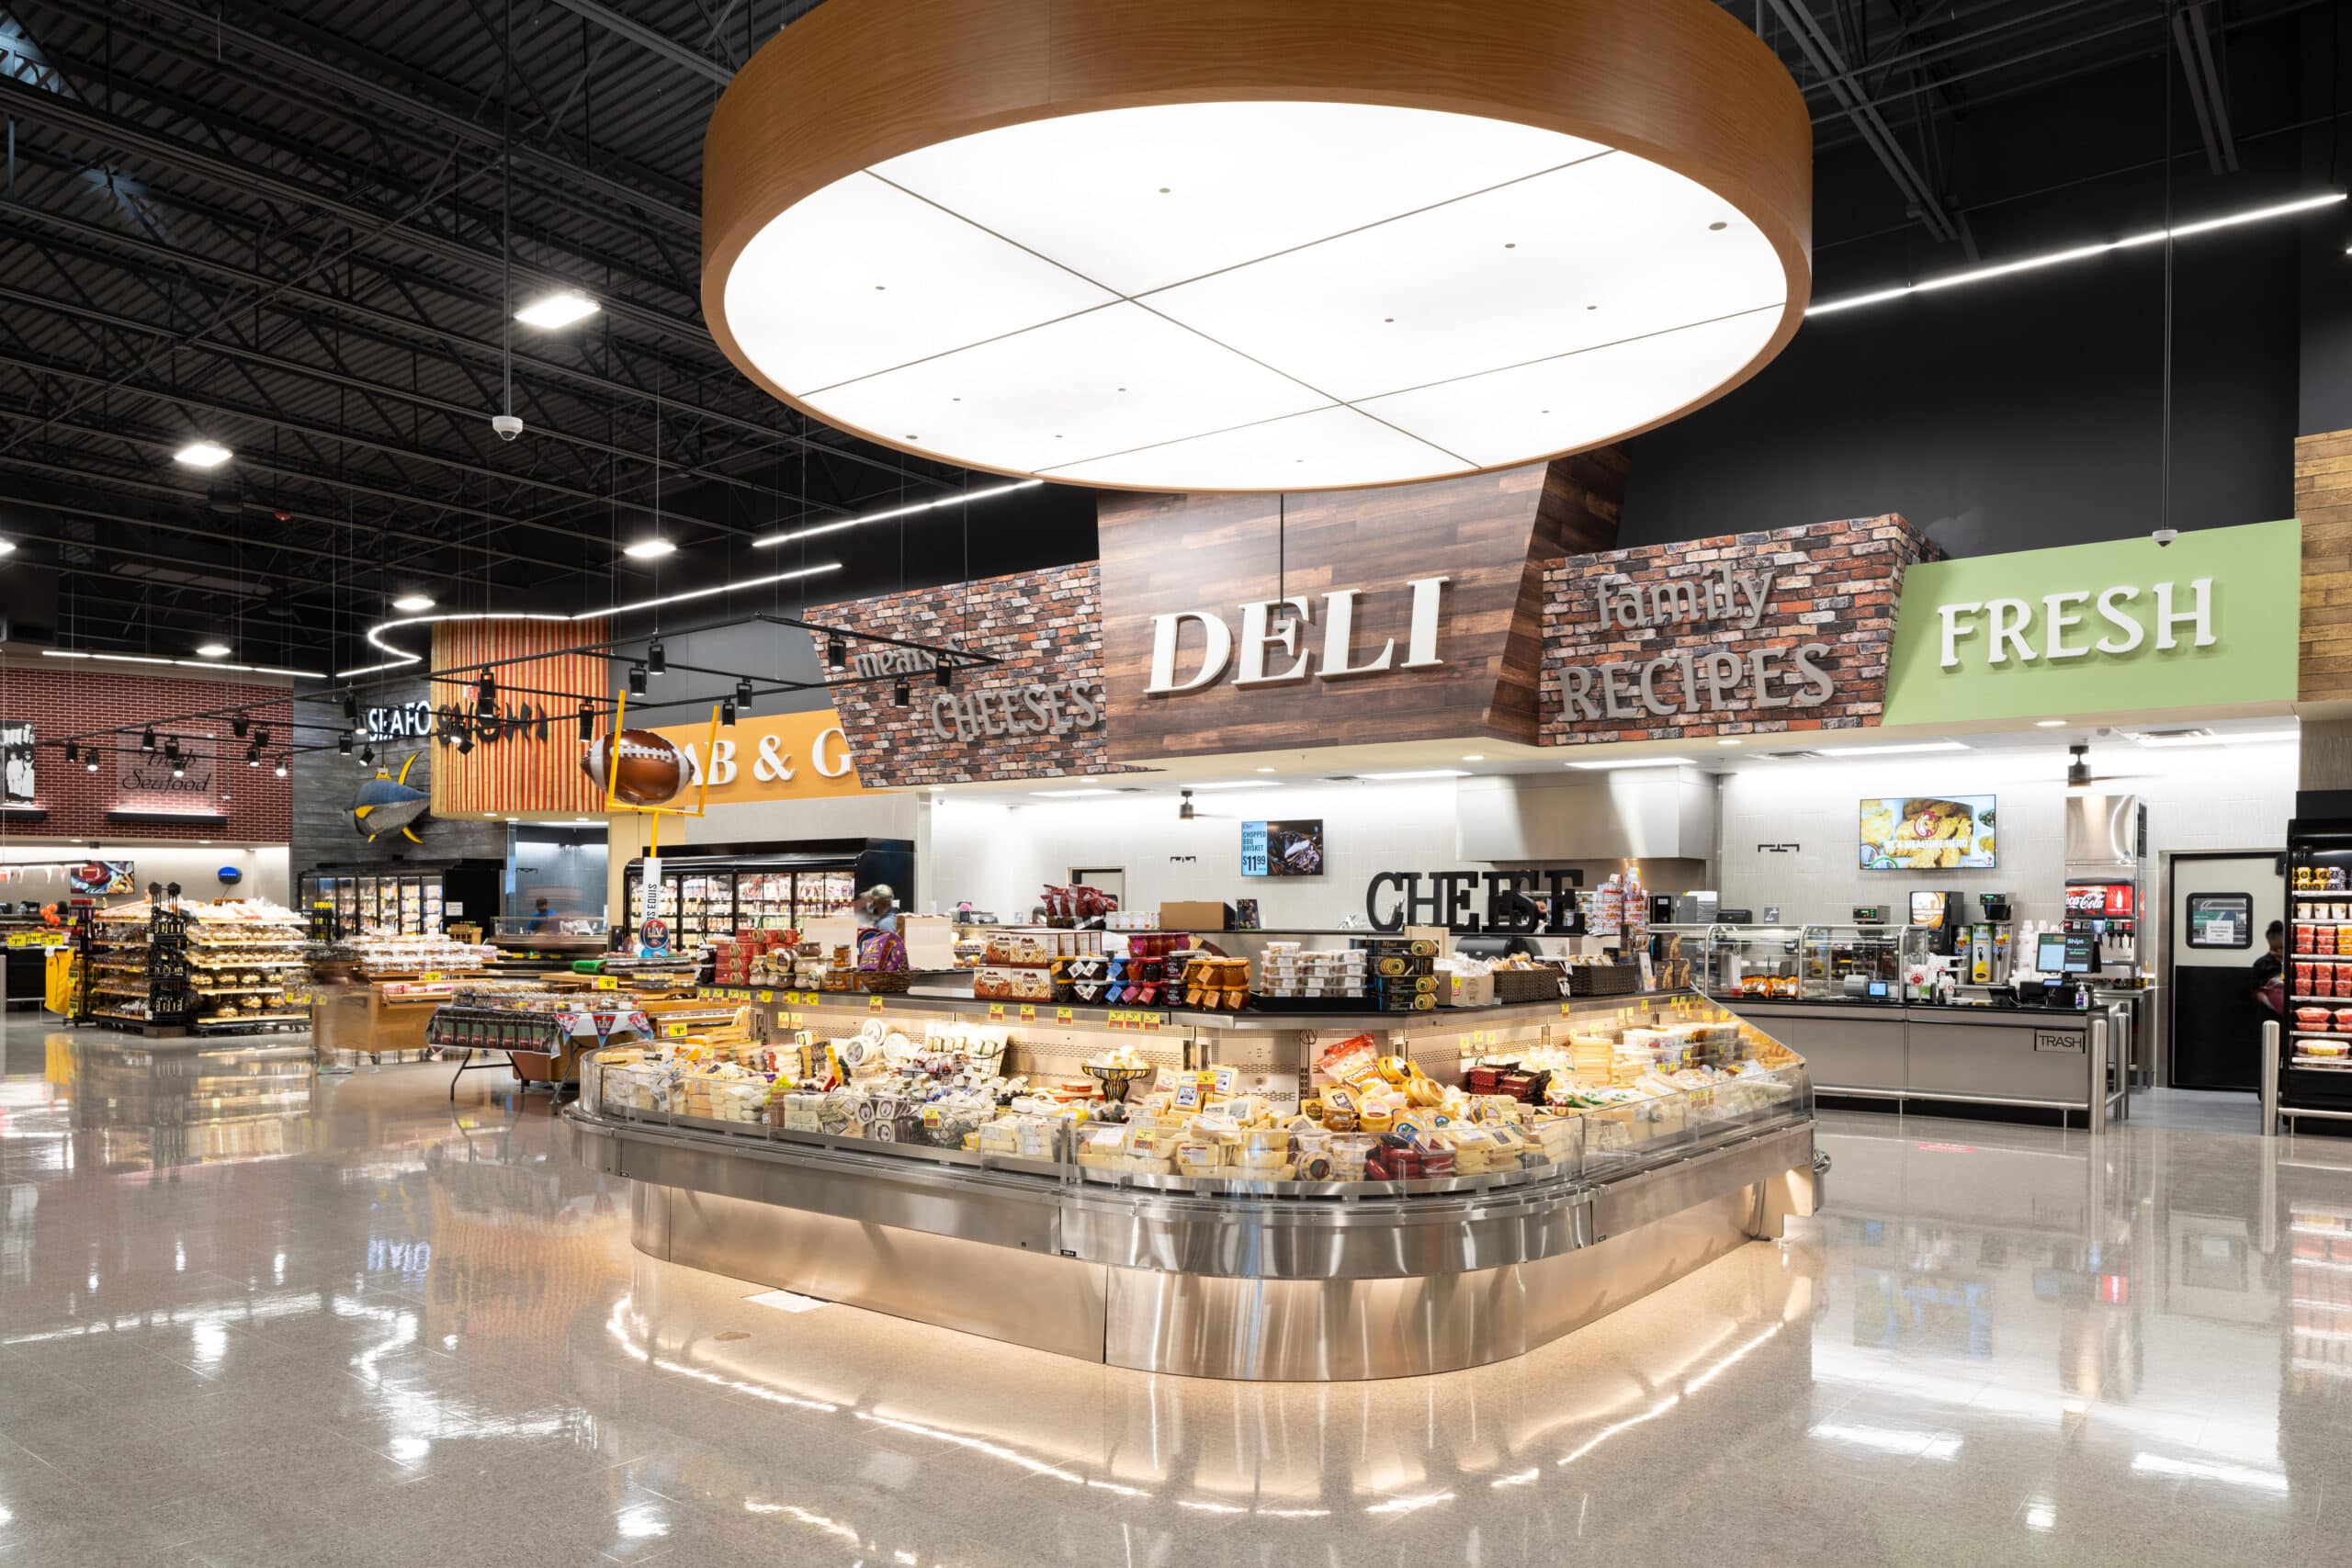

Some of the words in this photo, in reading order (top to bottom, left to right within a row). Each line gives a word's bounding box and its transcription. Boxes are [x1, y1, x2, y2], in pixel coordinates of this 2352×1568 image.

[1598, 560, 1775, 631] family
[1937, 577, 2219, 670] FRESH
[1144, 575, 1452, 694] DELI
[931, 682, 1099, 742] CHEESES
[1558, 641, 1836, 723] RECIPES
[122, 769, 211, 795] Seafood
[753, 735, 796, 782] &
[811, 727, 854, 778] G
[648, 884, 657, 909] EQUIS
[1366, 869, 1586, 933] CHEESE
[2039, 1034, 2083, 1048] TRASH
